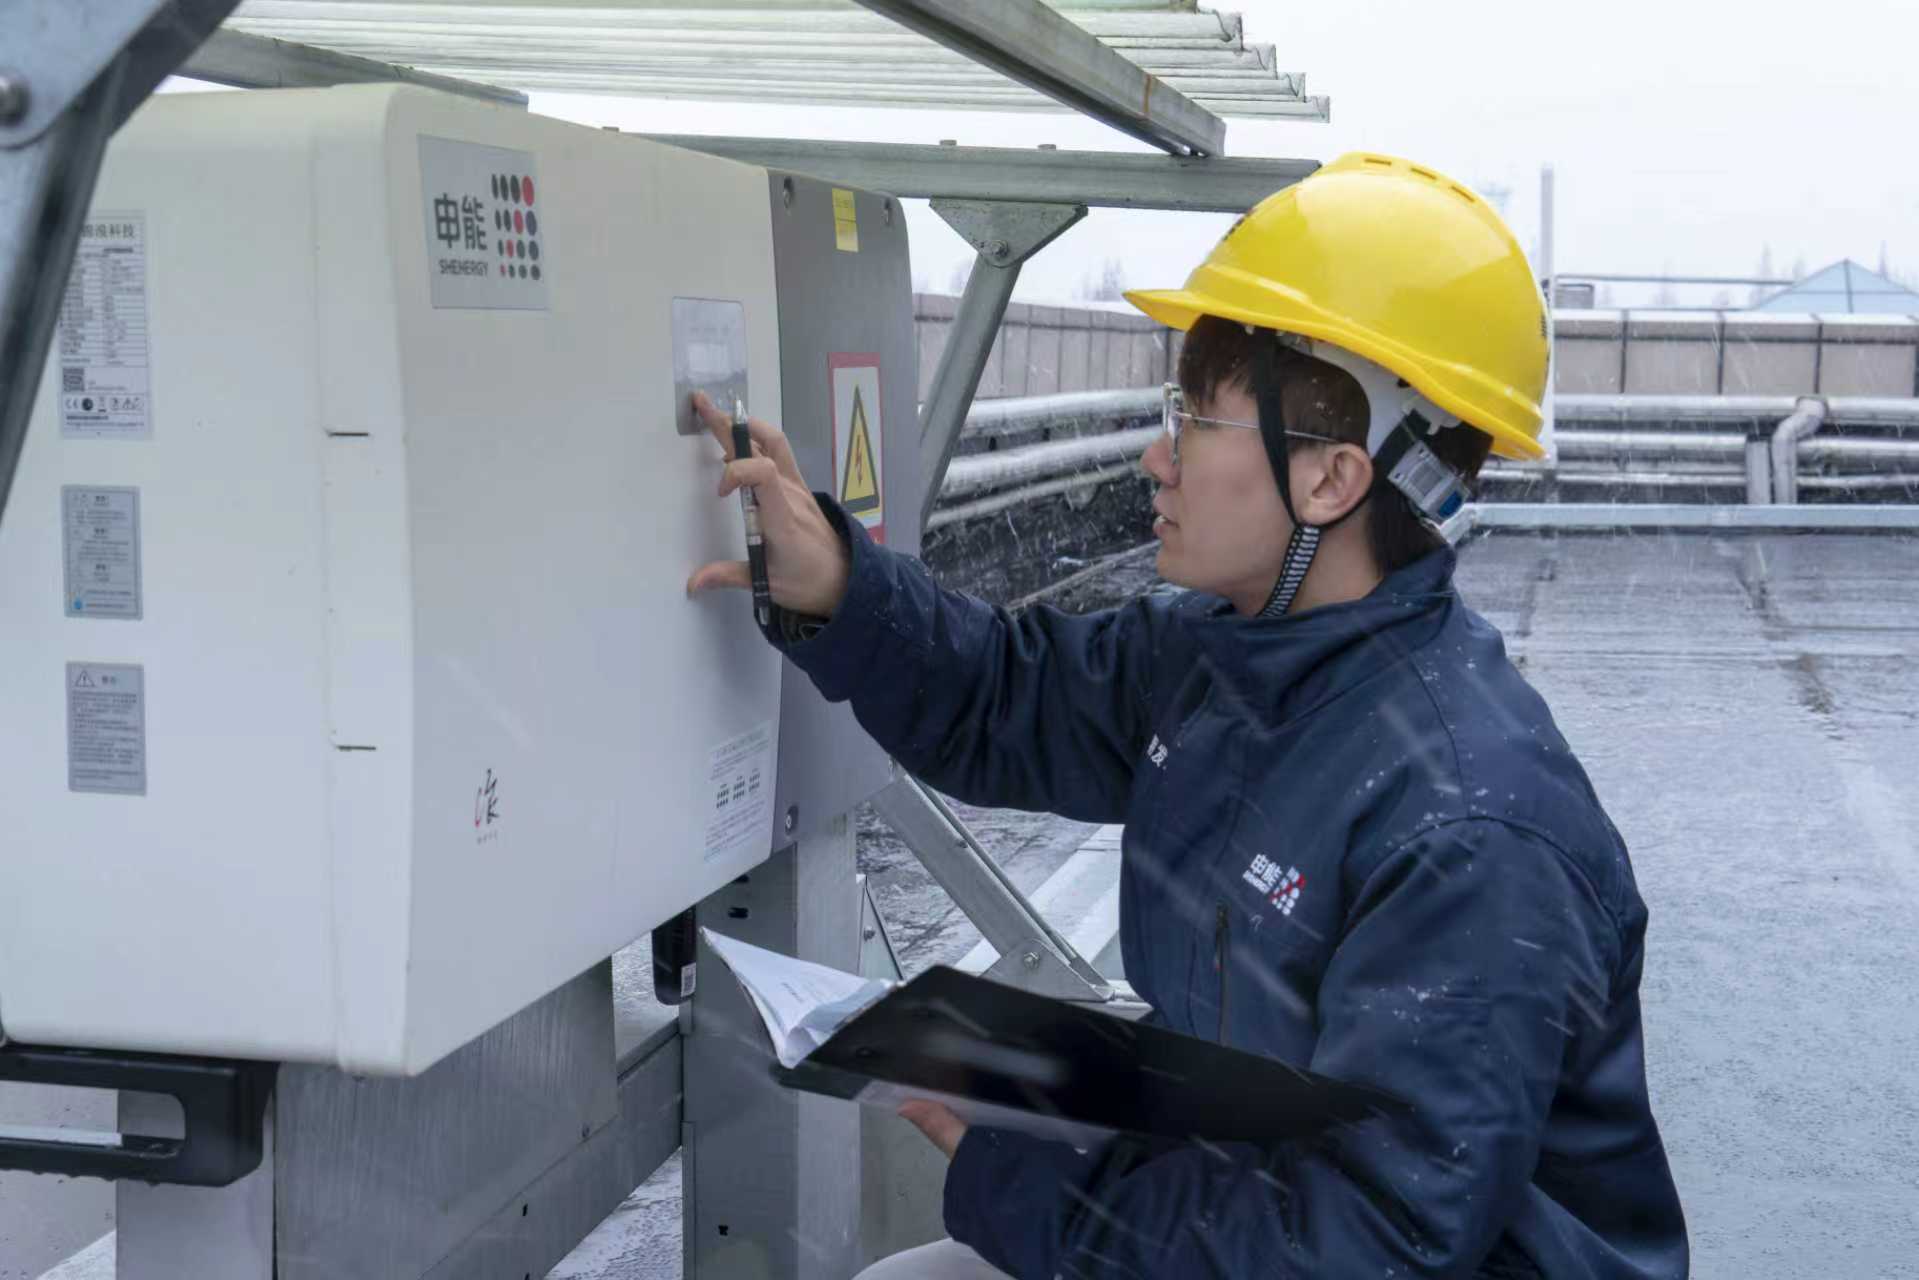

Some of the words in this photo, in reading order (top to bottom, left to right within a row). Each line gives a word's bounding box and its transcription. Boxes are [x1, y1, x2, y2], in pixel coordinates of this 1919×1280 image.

[434, 192, 488, 250] 申能
[439, 259, 488, 277] SHENERGY
[1250, 853, 1282, 888] 申能
